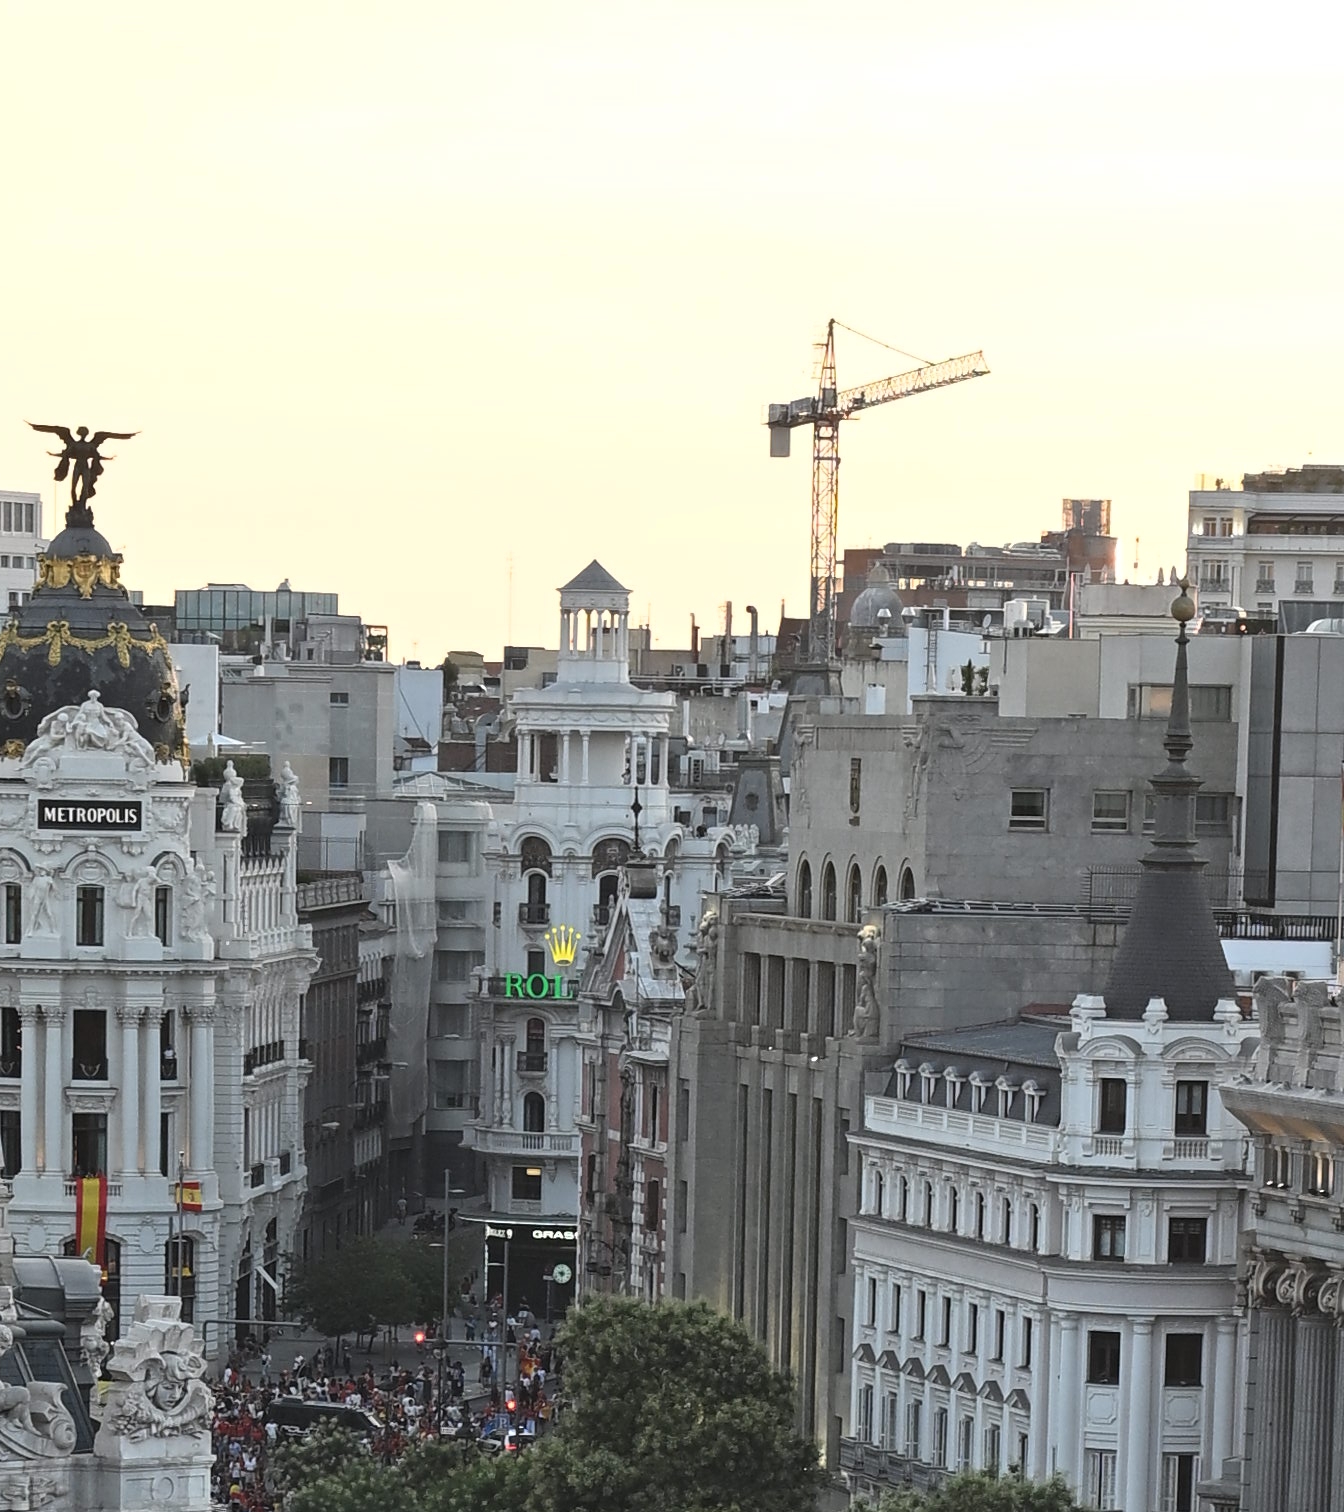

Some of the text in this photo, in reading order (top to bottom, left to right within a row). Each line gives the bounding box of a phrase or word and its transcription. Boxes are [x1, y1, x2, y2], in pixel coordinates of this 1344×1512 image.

[43, 807, 138, 823] METROPOLIS
[504, 971, 574, 999] ROL
[532, 1229, 578, 1240] GRAS
